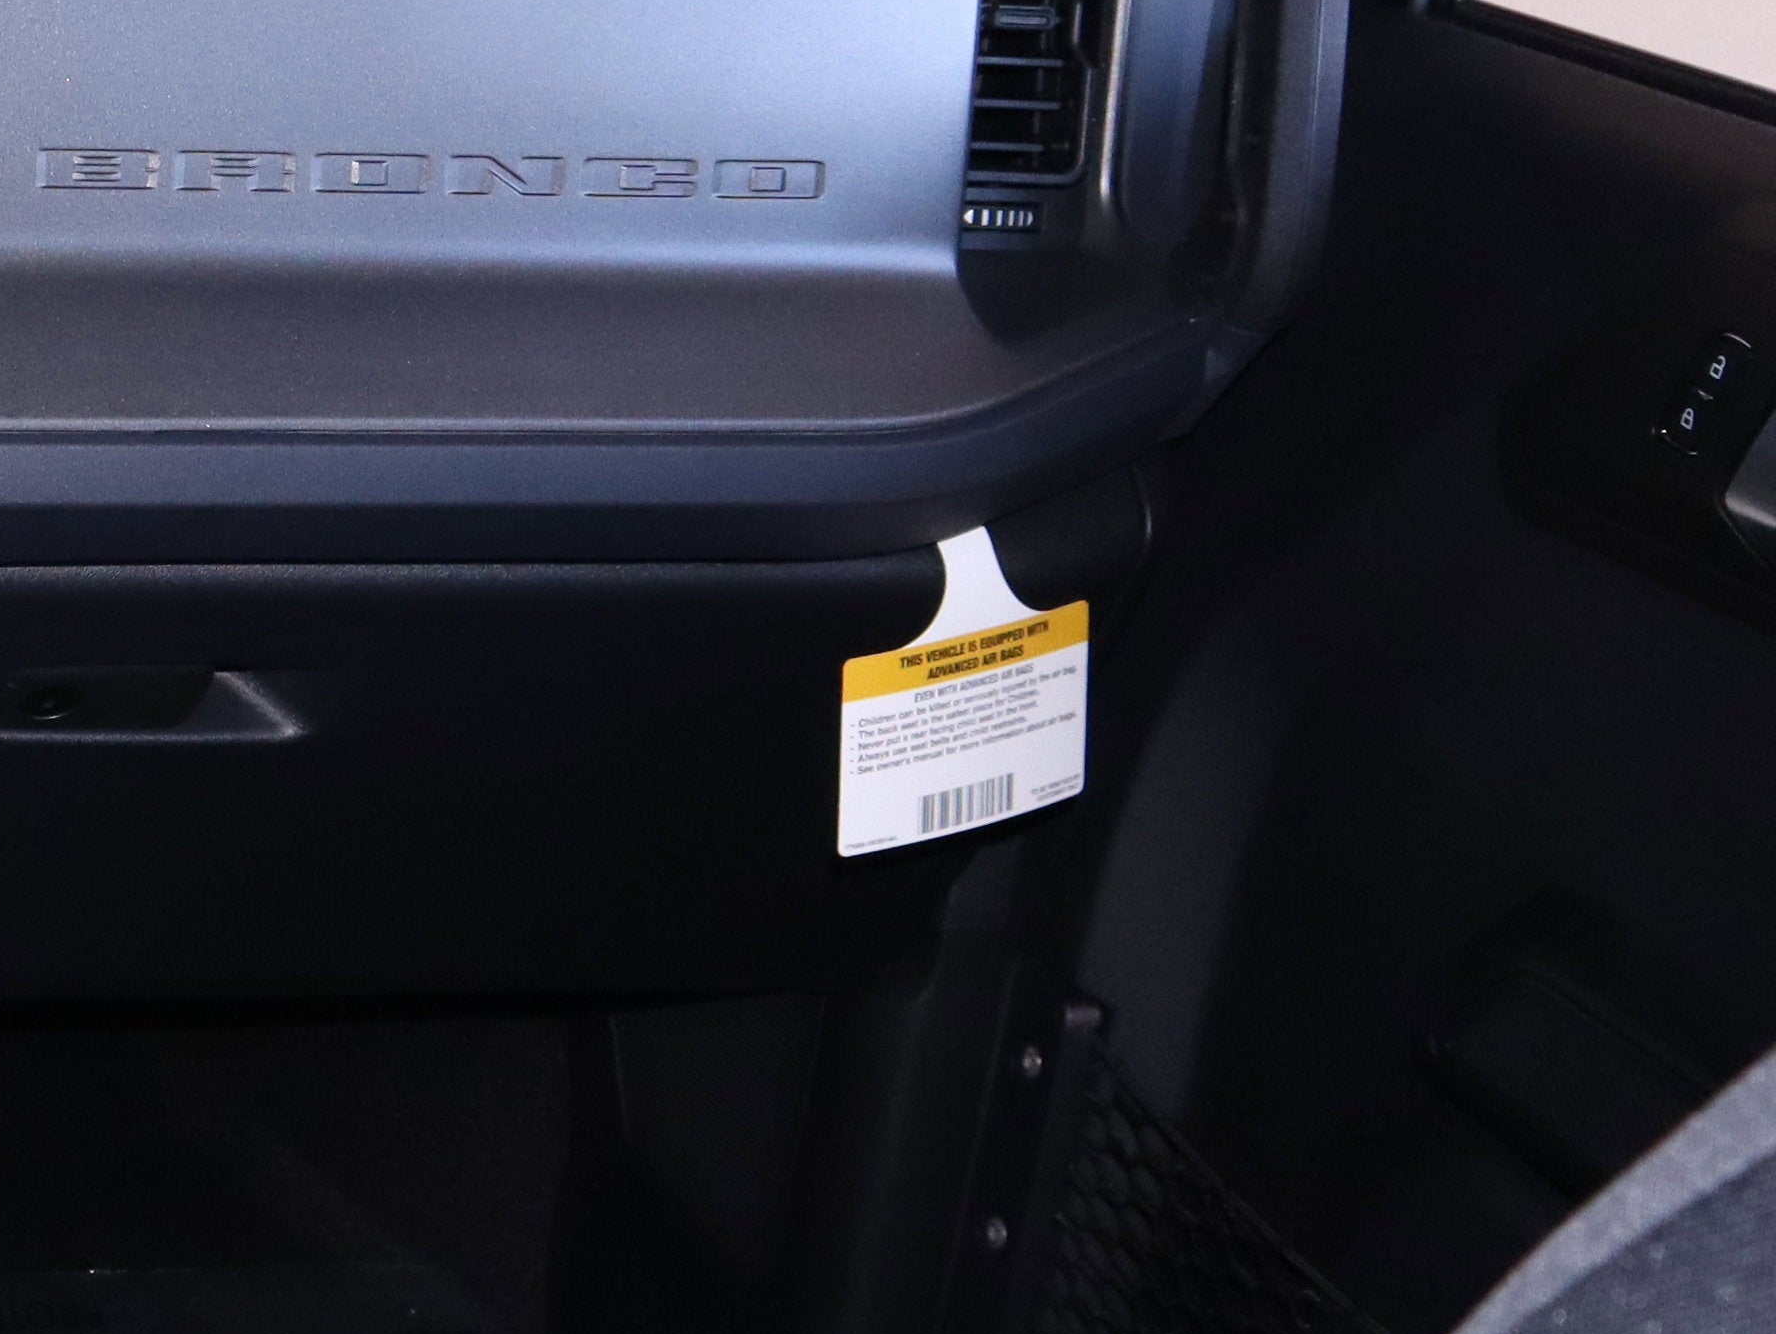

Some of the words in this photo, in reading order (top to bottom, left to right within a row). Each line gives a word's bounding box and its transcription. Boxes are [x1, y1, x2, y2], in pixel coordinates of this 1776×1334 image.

[35, 147, 826, 199] BRONCO
[900, 654, 923, 669] THIS
[926, 643, 965, 663] VEHICLE
[968, 640, 977, 652] IS
[980, 628, 1025, 649] EQUIPPED
[1027, 620, 1049, 637] WITH
[928, 658, 979, 679] ADVANCED
[982, 652, 997, 665] AIR
[1001, 645, 1024, 660] BAGS
[960, 673, 999, 691] ADVANCED
